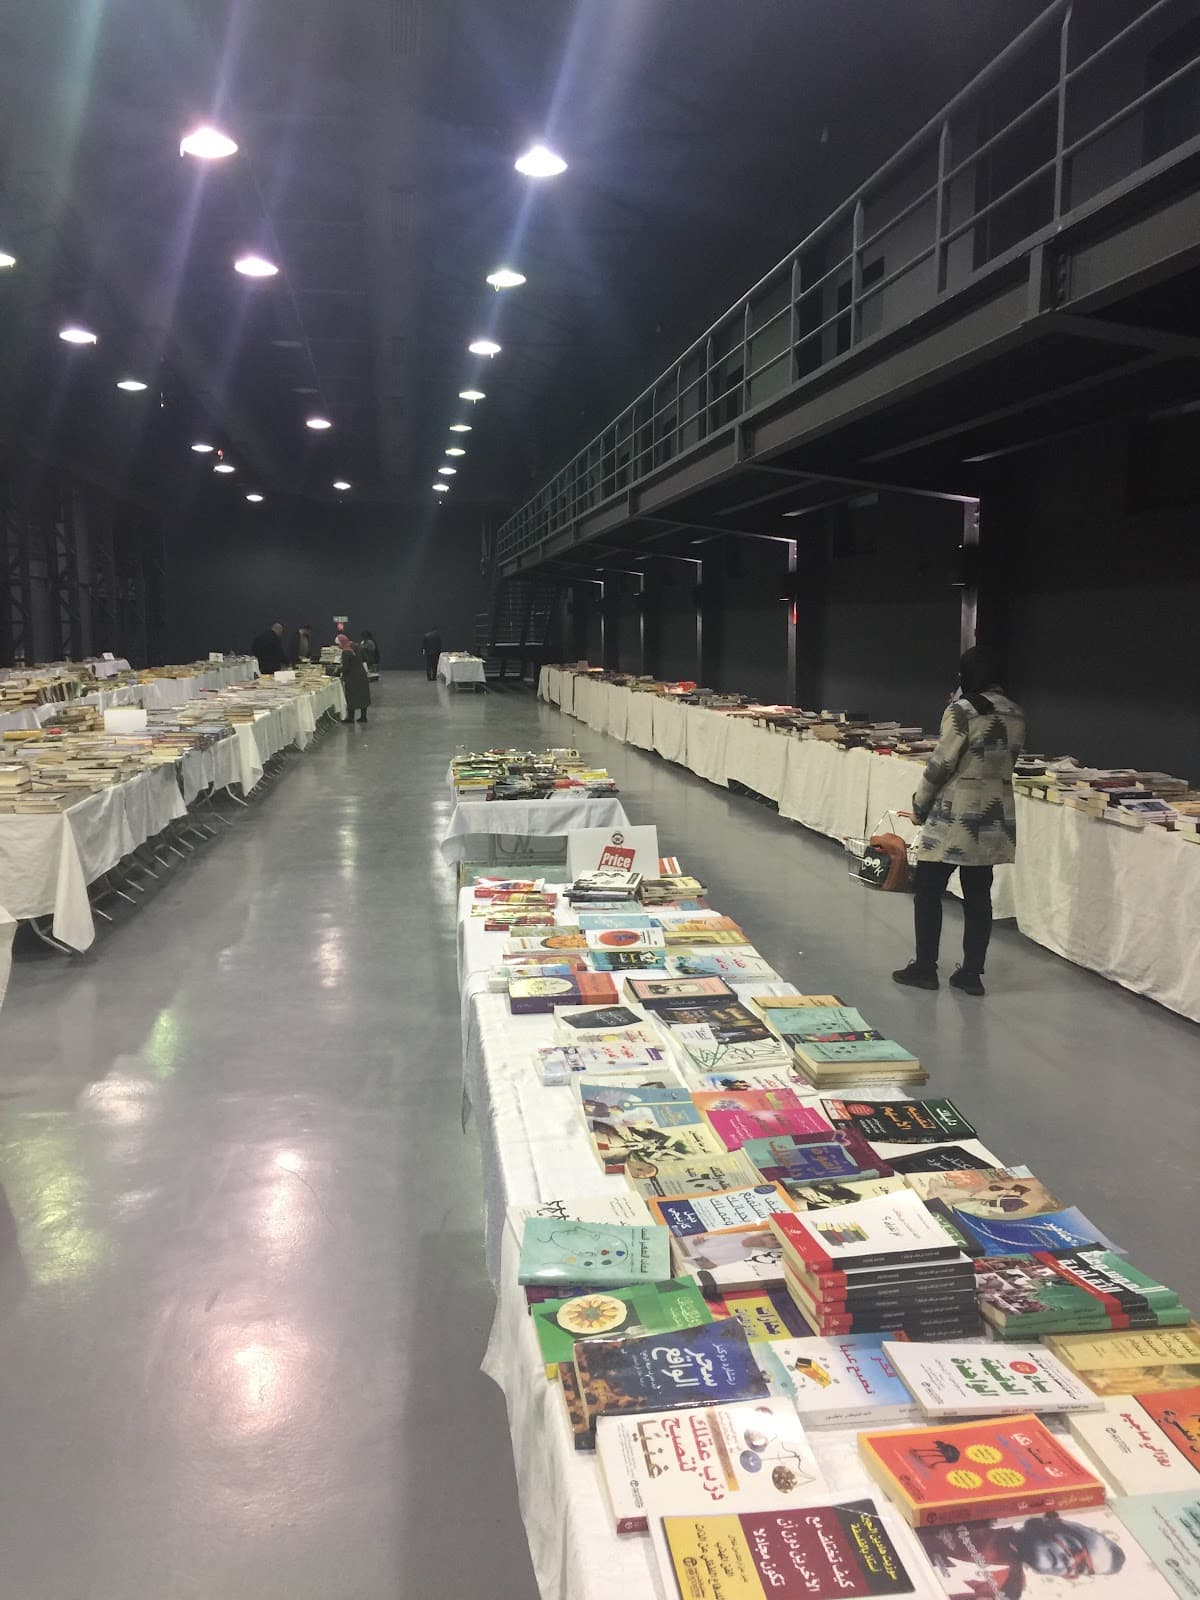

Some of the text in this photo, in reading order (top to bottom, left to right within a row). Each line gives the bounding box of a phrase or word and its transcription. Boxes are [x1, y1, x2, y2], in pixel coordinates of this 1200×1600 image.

[601, 852, 632, 869] Price
[936, 1108, 958, 1126] دليلك
[710, 1198, 733, 1225] وعملك
[727, 1195, 750, 1222] بحياتك
[1057, 1259, 1124, 1294] الثقافية
[651, 1347, 700, 1388] الواقع
[684, 1348, 718, 1387] سحر
[950, 1357, 1000, 1397] الواحدة
[981, 1357, 1030, 1396] الدقيقة
[661, 1417, 697, 1472] لتصبح
[688, 1415, 712, 1461] عقلك
[753, 1527, 785, 1587] تكون مجادلا
[776, 1516, 820, 1592] الآخرين دون أن
[805, 1515, 855, 1589] كيف تختلف مع
